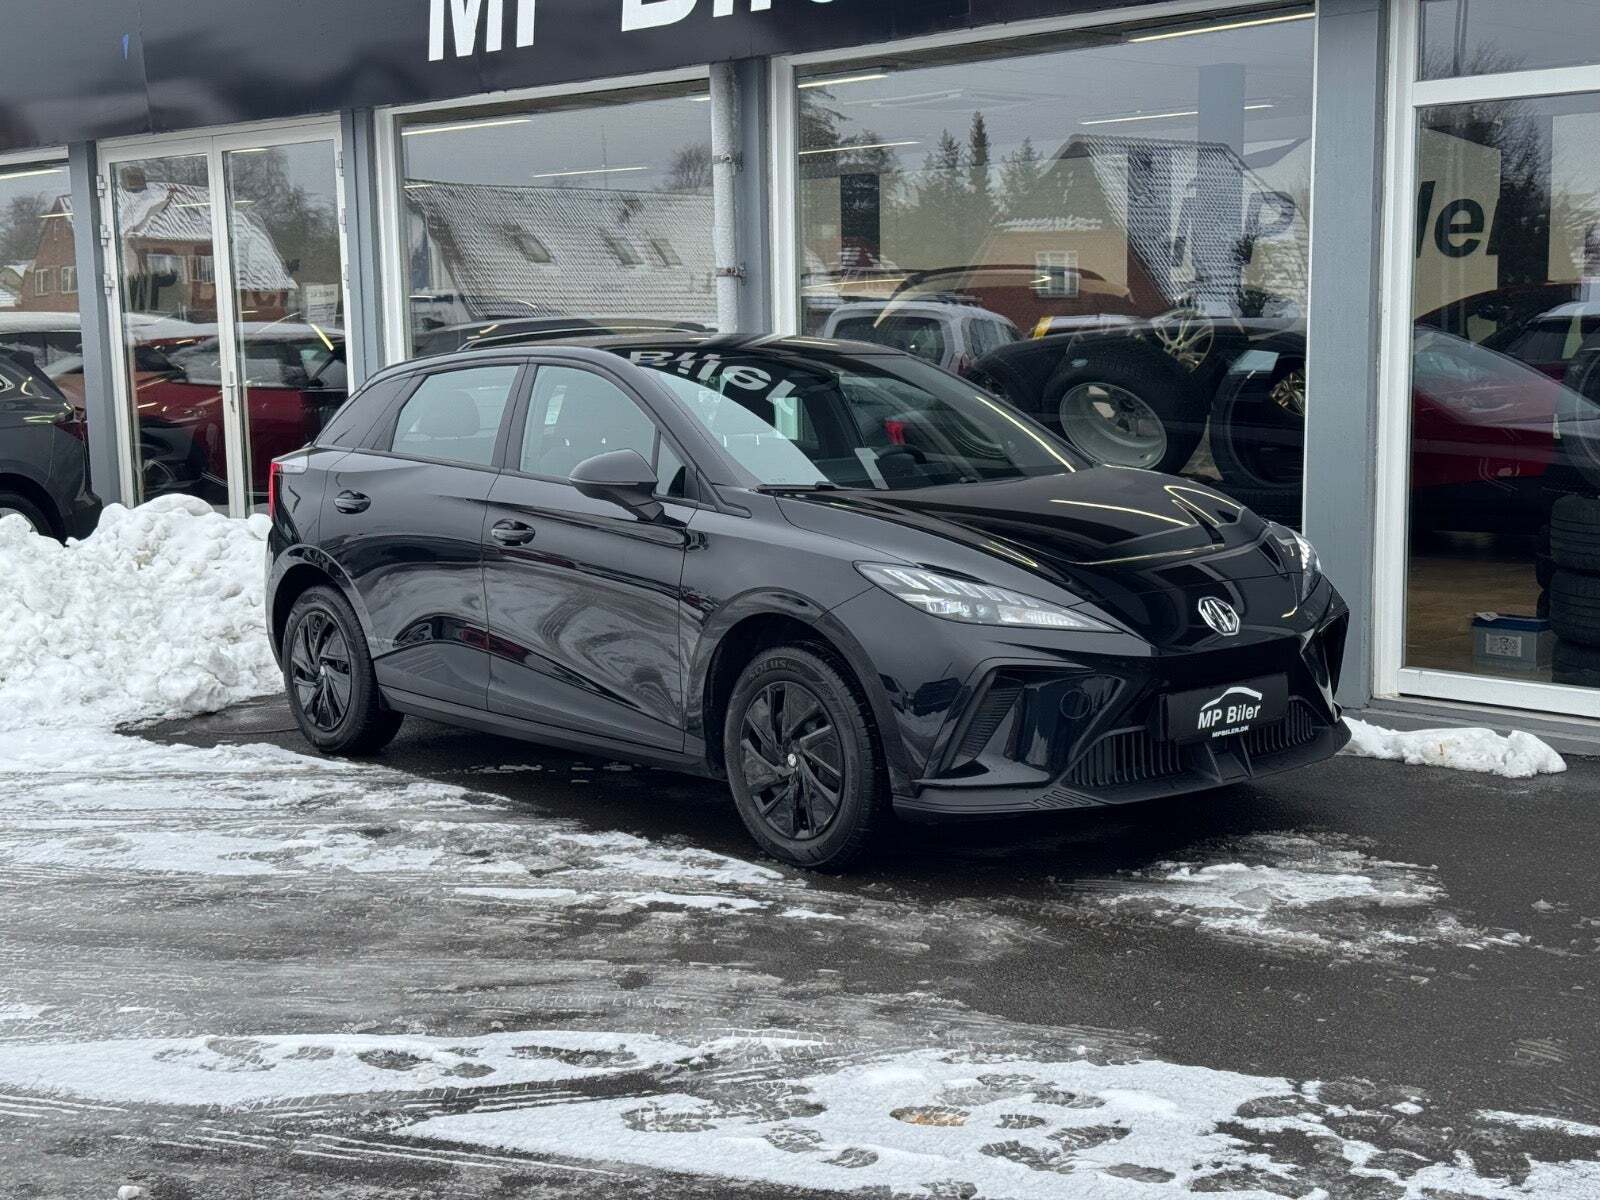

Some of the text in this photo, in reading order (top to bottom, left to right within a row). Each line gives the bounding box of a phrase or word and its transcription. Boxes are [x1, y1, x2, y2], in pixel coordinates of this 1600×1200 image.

[428, 0, 535, 61] M
[1198, 704, 1261, 730] MP Biler
[1212, 725, 1250, 738] MPBILER.DK
